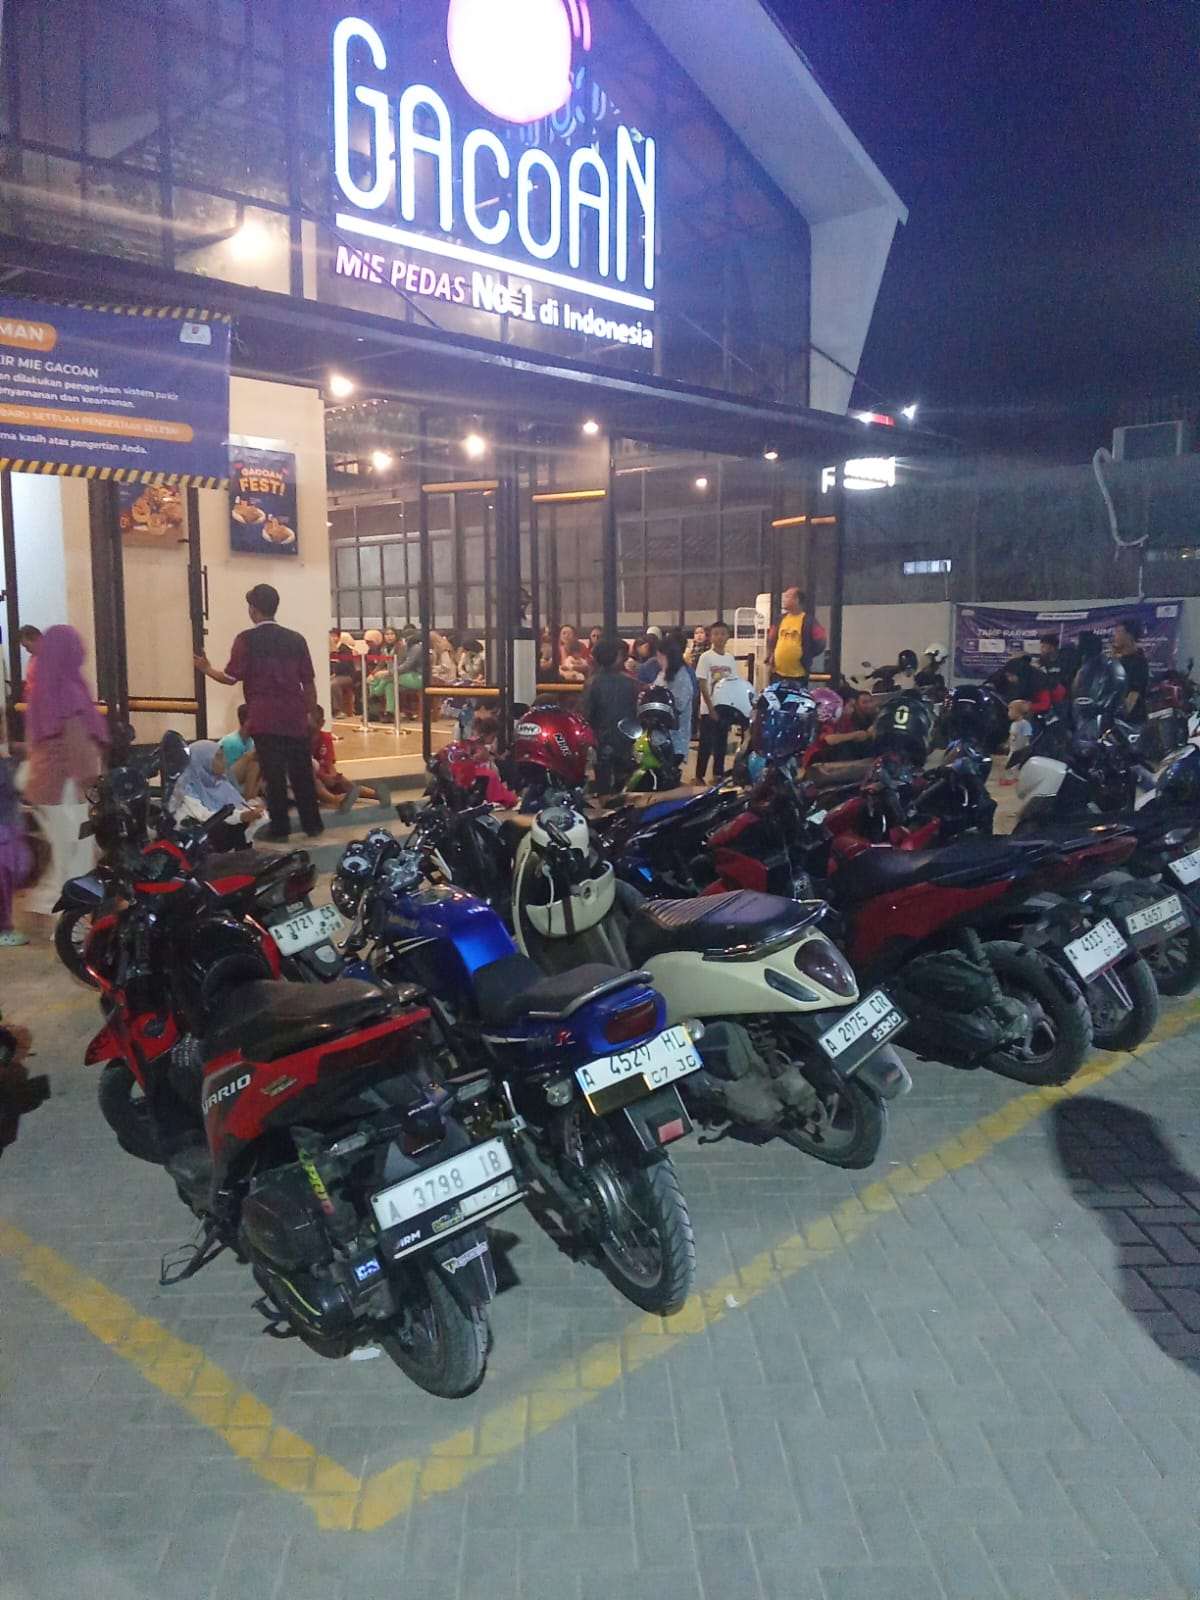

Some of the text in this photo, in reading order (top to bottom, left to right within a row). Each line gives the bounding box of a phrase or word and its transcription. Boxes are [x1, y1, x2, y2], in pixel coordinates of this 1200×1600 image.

[333, 17, 656, 290] GACOAN
[336, 246, 384, 283] MIE
[390, 260, 465, 303] PEDAS
[540, 299, 559, 329] di
[564, 303, 655, 349] Indonesia
[18, 357, 42, 370] MIE
[45, 361, 99, 378] GACOAN
[60, 393, 80, 403] dan
[19, 431, 46, 443] kasih
[240, 477, 287, 496] FEST!
[274, 928, 284, 940] A
[825, 1038, 838, 1054] A
[869, 995, 889, 1014] CR
[582, 1068, 595, 1087] A
[661, 1030, 686, 1053] HL
[201, 1074, 251, 1115] VARIO
[388, 1199, 401, 1223] A
[413, 1168, 464, 1208] 3798
[479, 1150, 501, 1177] IB
